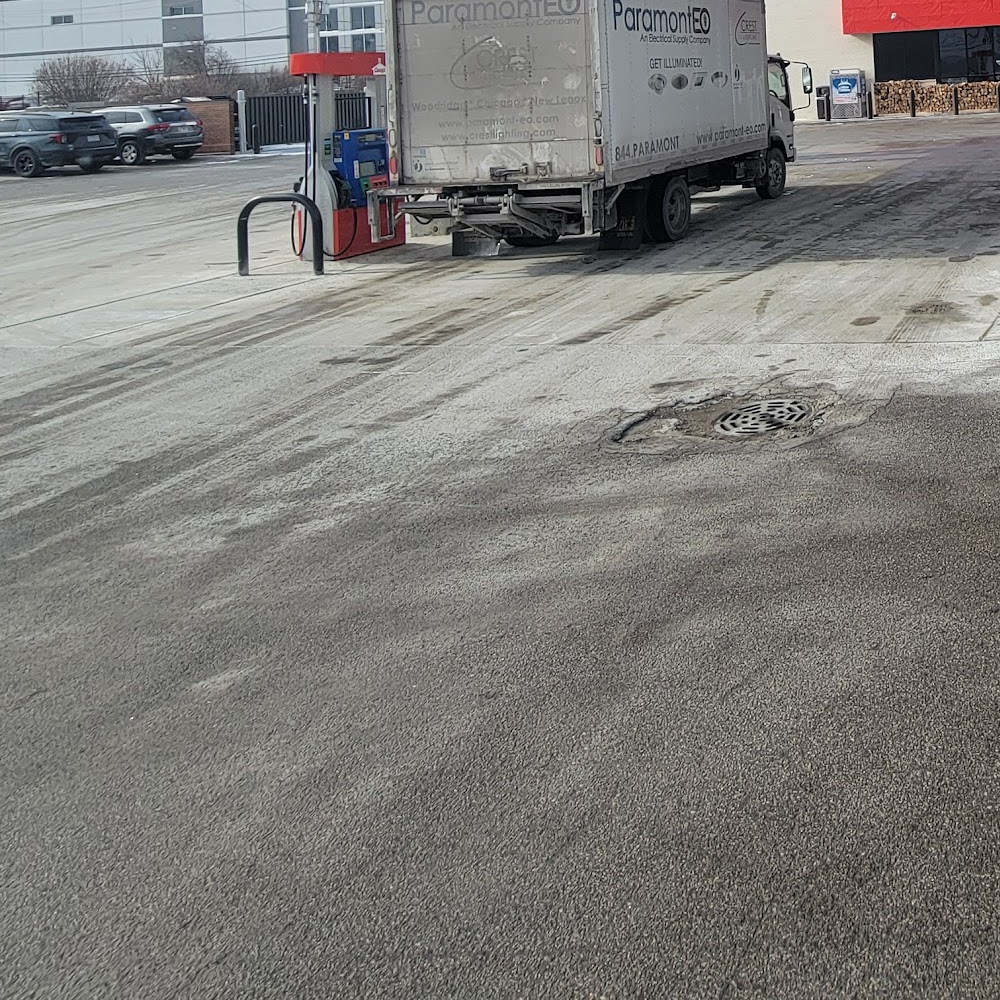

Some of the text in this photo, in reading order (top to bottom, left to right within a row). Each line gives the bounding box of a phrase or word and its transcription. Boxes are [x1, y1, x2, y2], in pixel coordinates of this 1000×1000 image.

[536, 16, 581, 27] Company
[640, 33, 711, 46] An Electrical Supply Company
[649, 57, 703, 69] GET ILLUMINATED!
[615, 122, 766, 162] 844.PARAMONT www.paramont-eo.com
